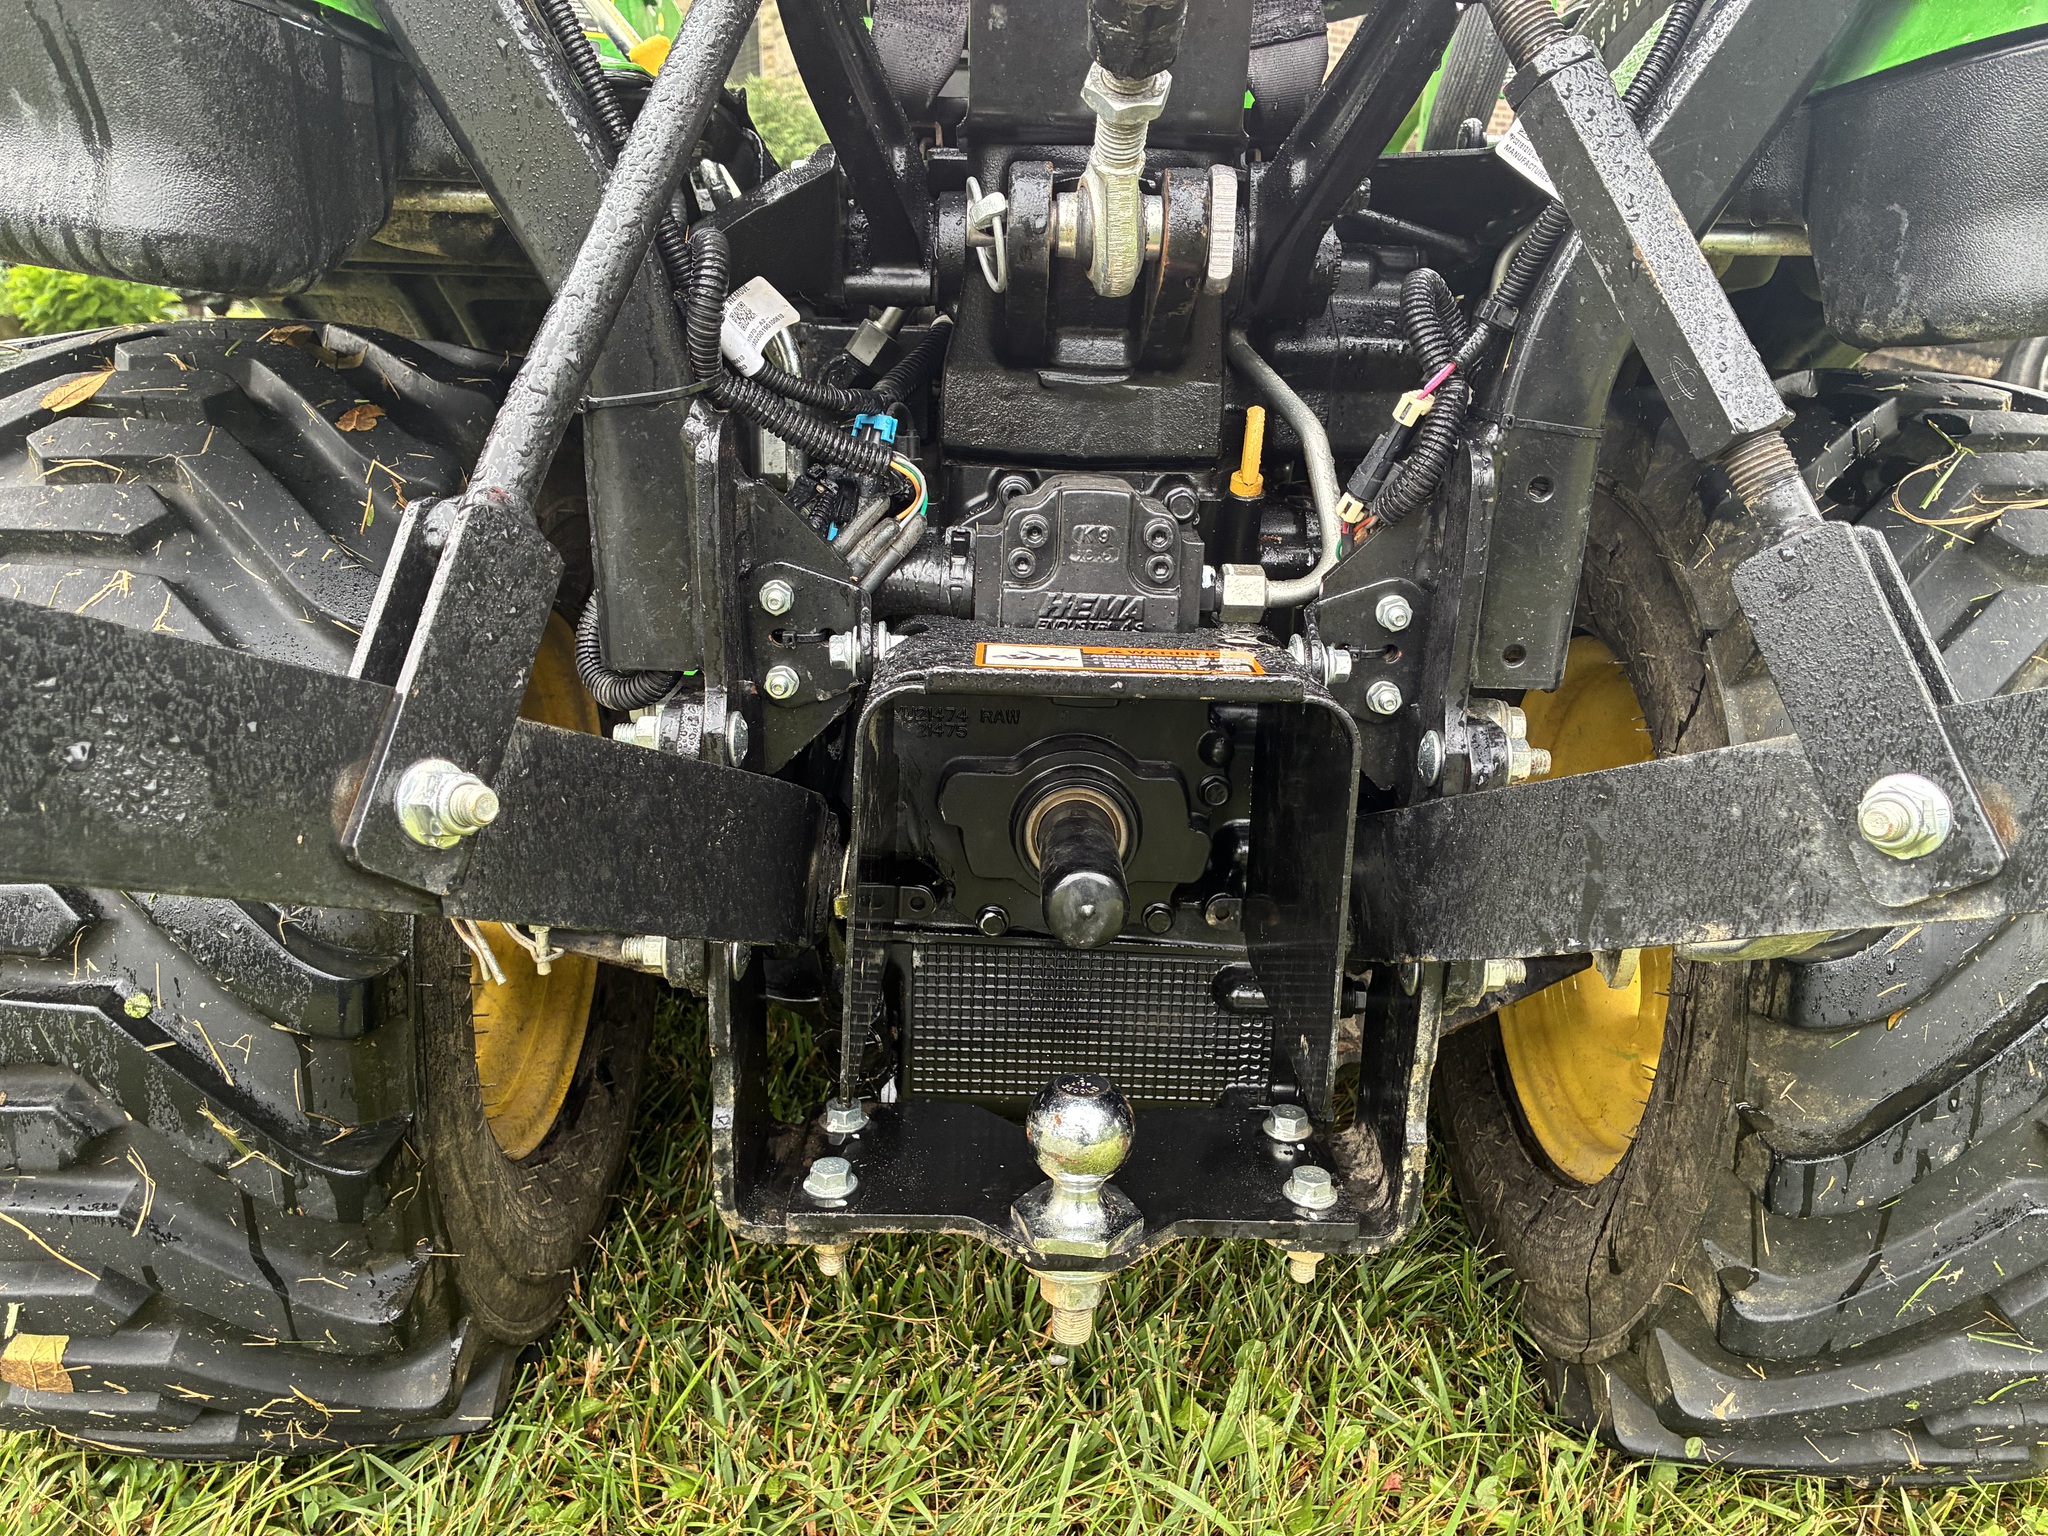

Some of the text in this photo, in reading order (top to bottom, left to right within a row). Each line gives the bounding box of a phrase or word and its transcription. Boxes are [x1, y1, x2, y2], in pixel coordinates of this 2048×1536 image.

[1503, 143, 1551, 183] MANUFACTURED
[726, 284, 751, 306] REMOVE
[1038, 592, 1146, 621] HEMA
[980, 707, 1021, 725] RAW
[916, 721, 968, 739] 21475
